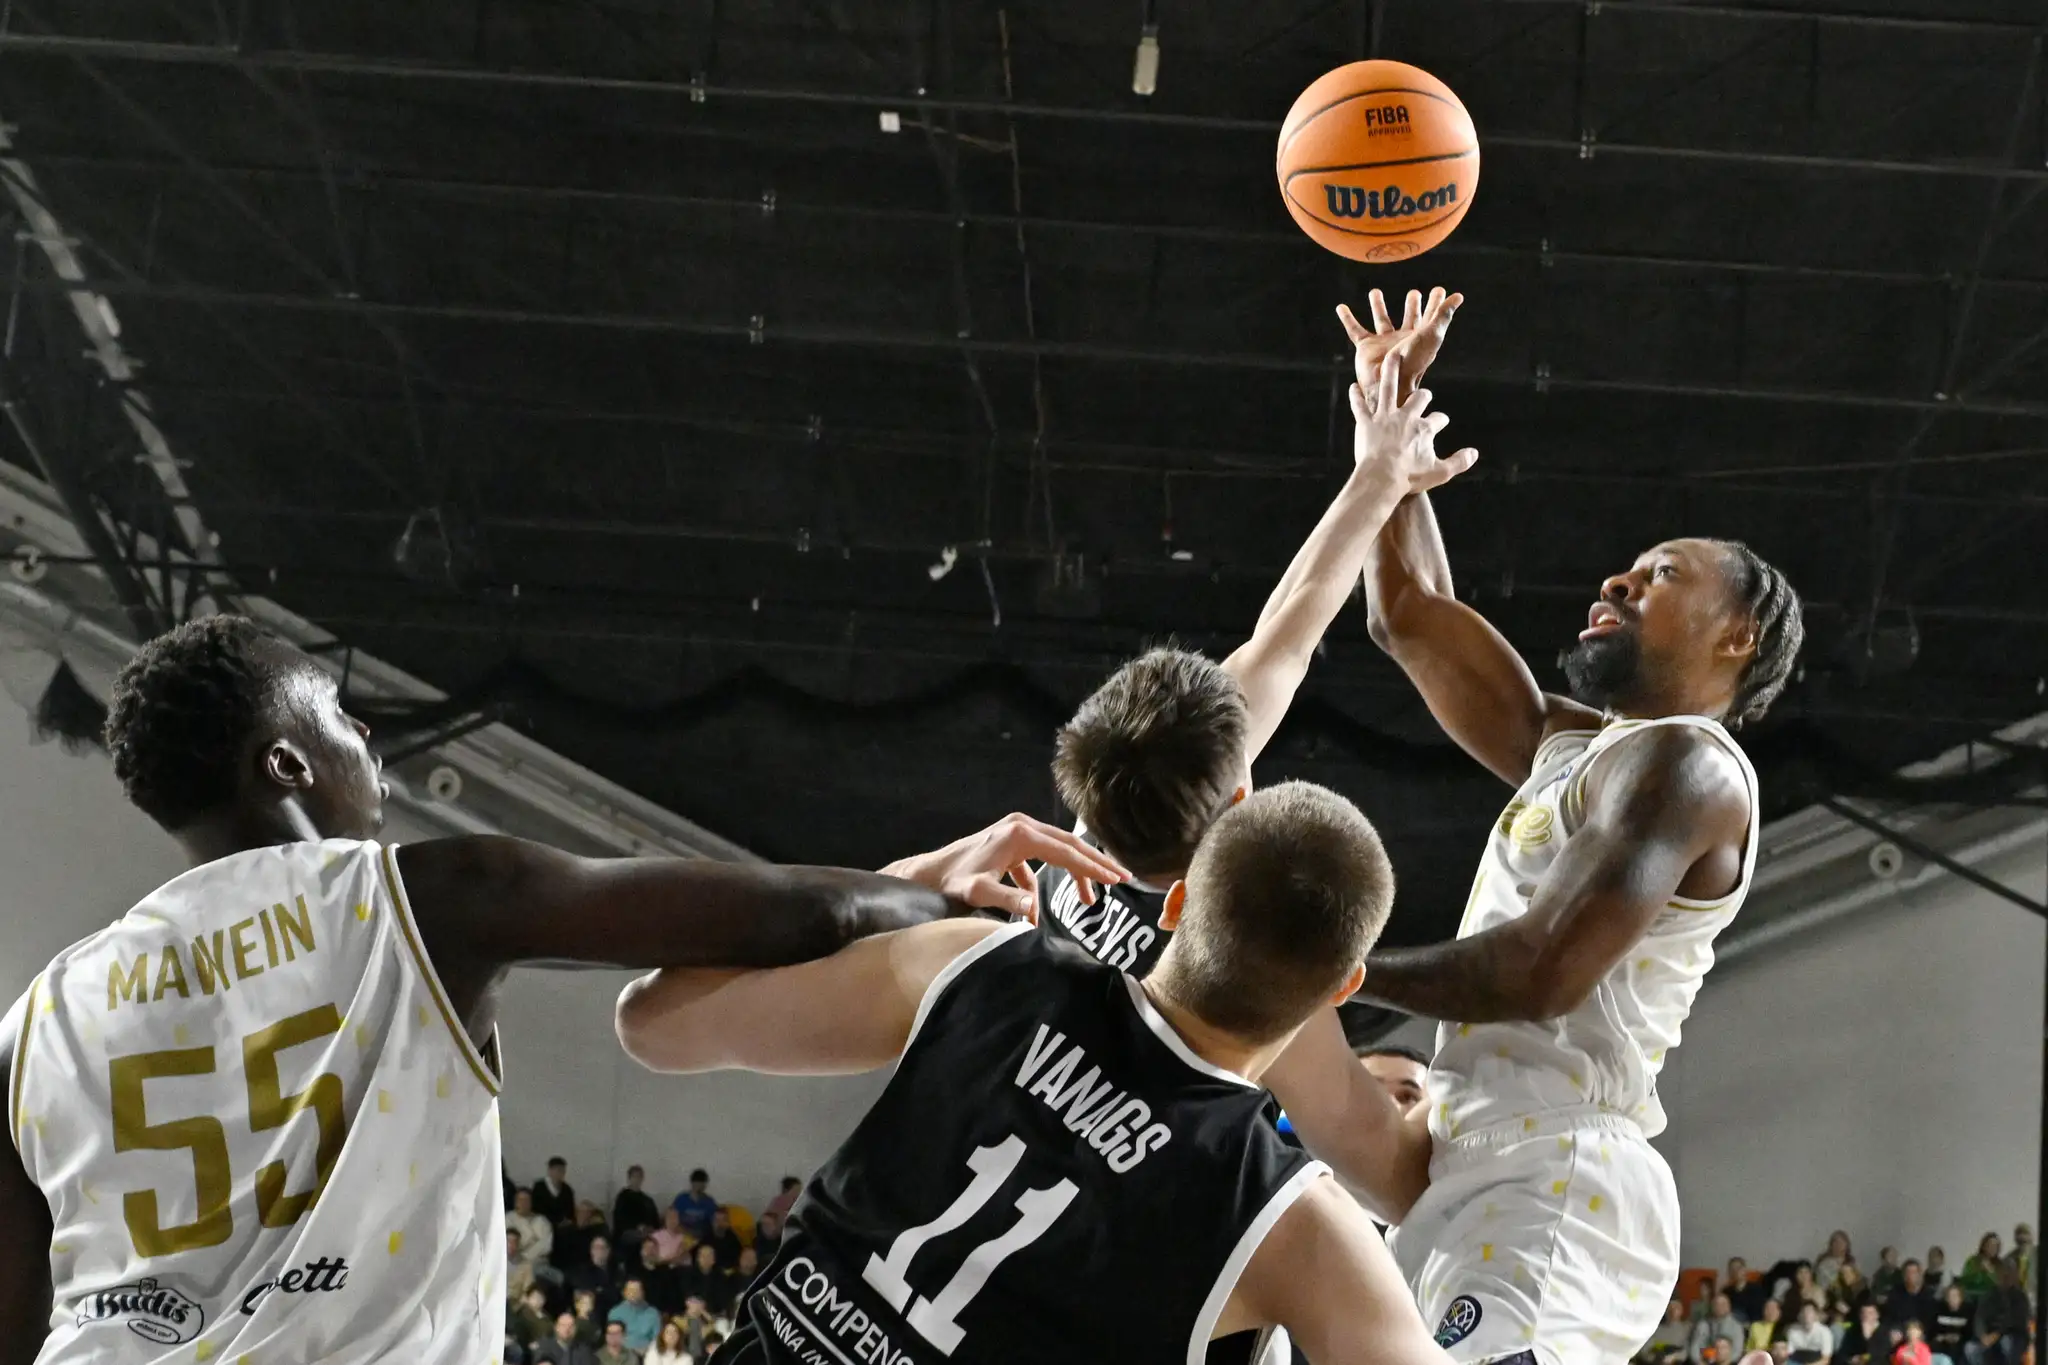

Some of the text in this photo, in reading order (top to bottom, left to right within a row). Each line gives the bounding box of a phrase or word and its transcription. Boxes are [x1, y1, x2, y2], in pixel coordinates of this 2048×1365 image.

[1364, 105, 1410, 127] FIBA
[1323, 182, 1457, 219] Wilson
[107, 893, 317, 1011] MAWEIN
[109, 1002, 347, 1258] 55
[1014, 1022, 1172, 1174] VANAGS
[861, 1133, 1081, 1358] 11
